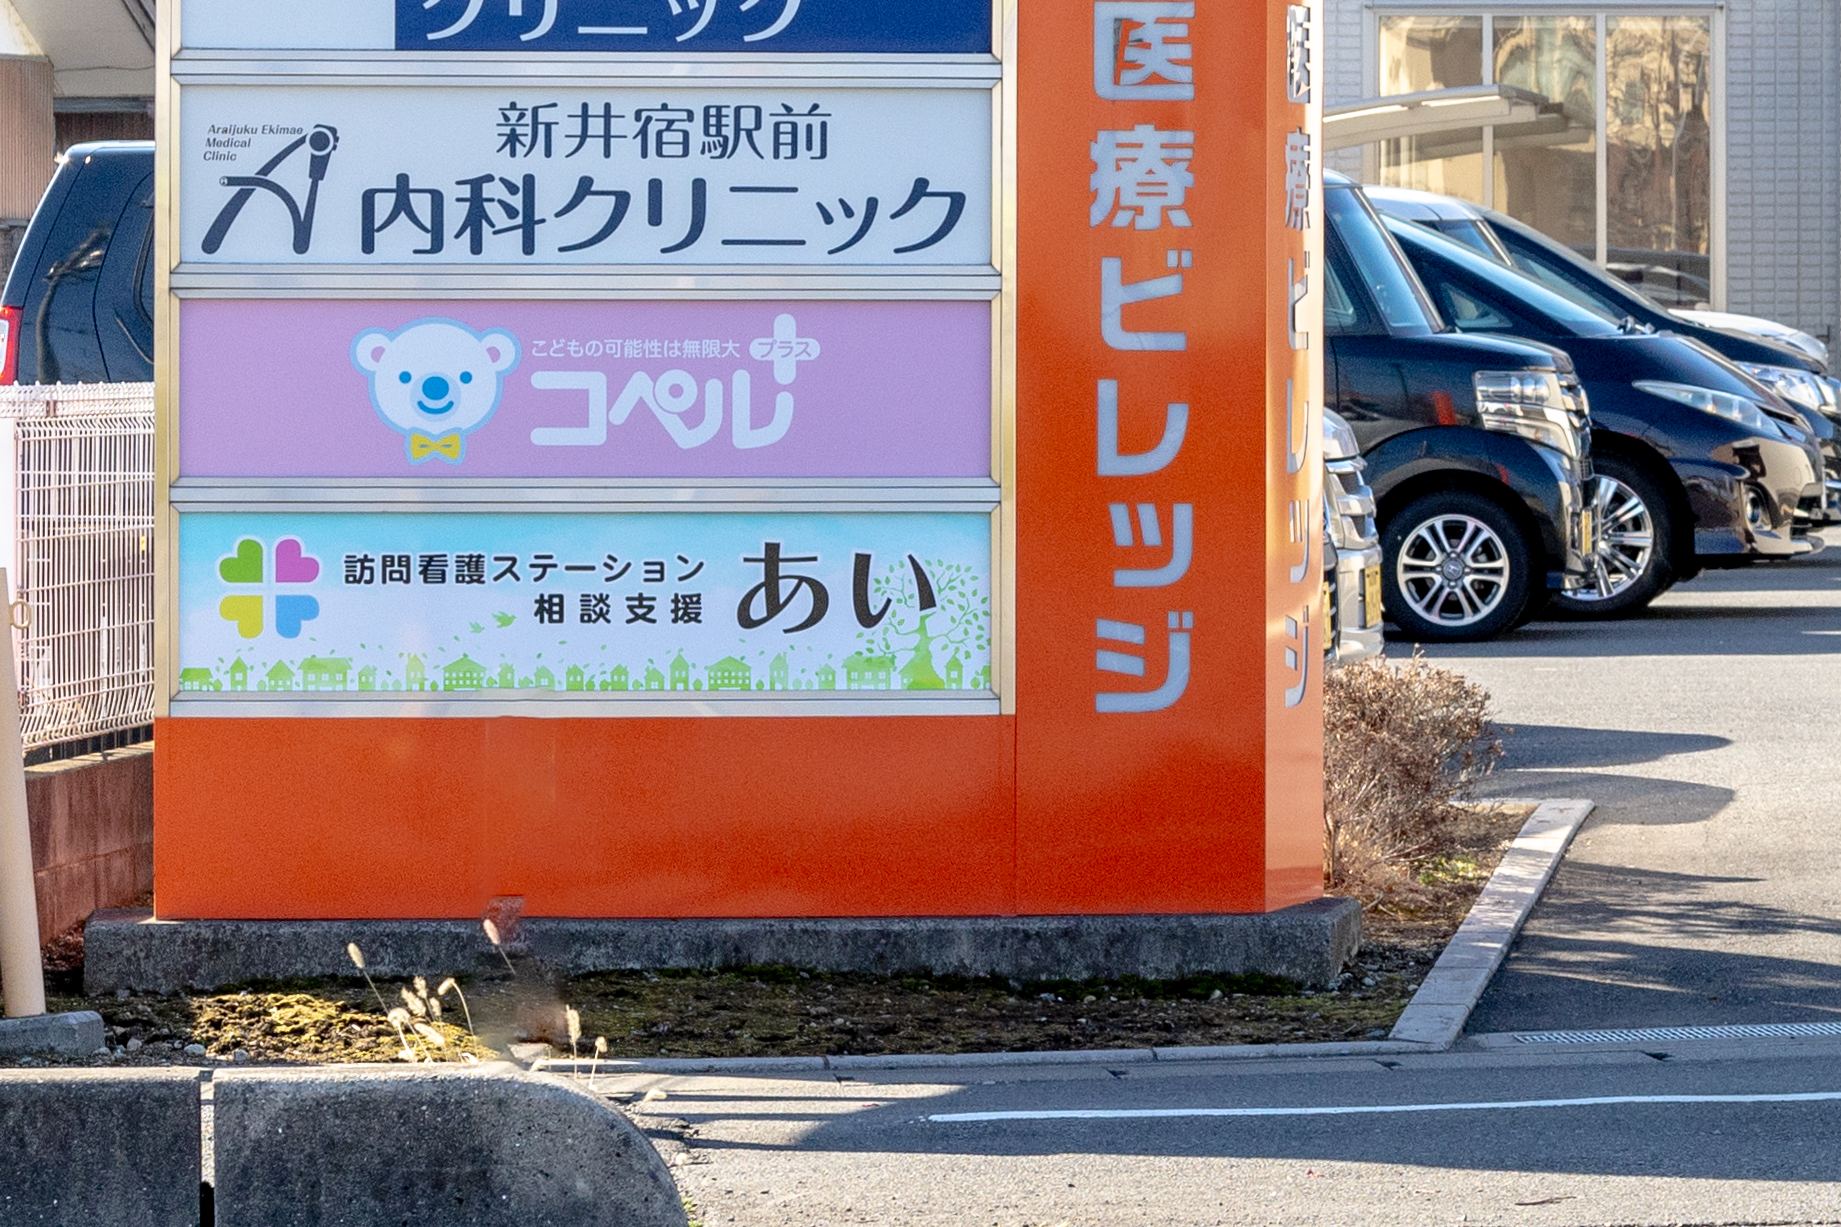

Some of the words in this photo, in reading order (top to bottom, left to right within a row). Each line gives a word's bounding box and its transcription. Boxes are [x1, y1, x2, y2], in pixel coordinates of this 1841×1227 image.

[205, 137, 252, 148] Medical
[207, 124, 258, 136] Araijuku
[495, 102, 833, 161] 新井宿駅前
[203, 150, 237, 161] Clinic
[360, 173, 967, 257] 内科クリニック
[531, 338, 741, 359] こどもの可能性は無限大
[757, 339, 813, 359] プラス
[343, 552, 706, 585] 訪問看護ステーション
[735, 541, 937, 634] あい
[533, 590, 705, 626] 相談支援
